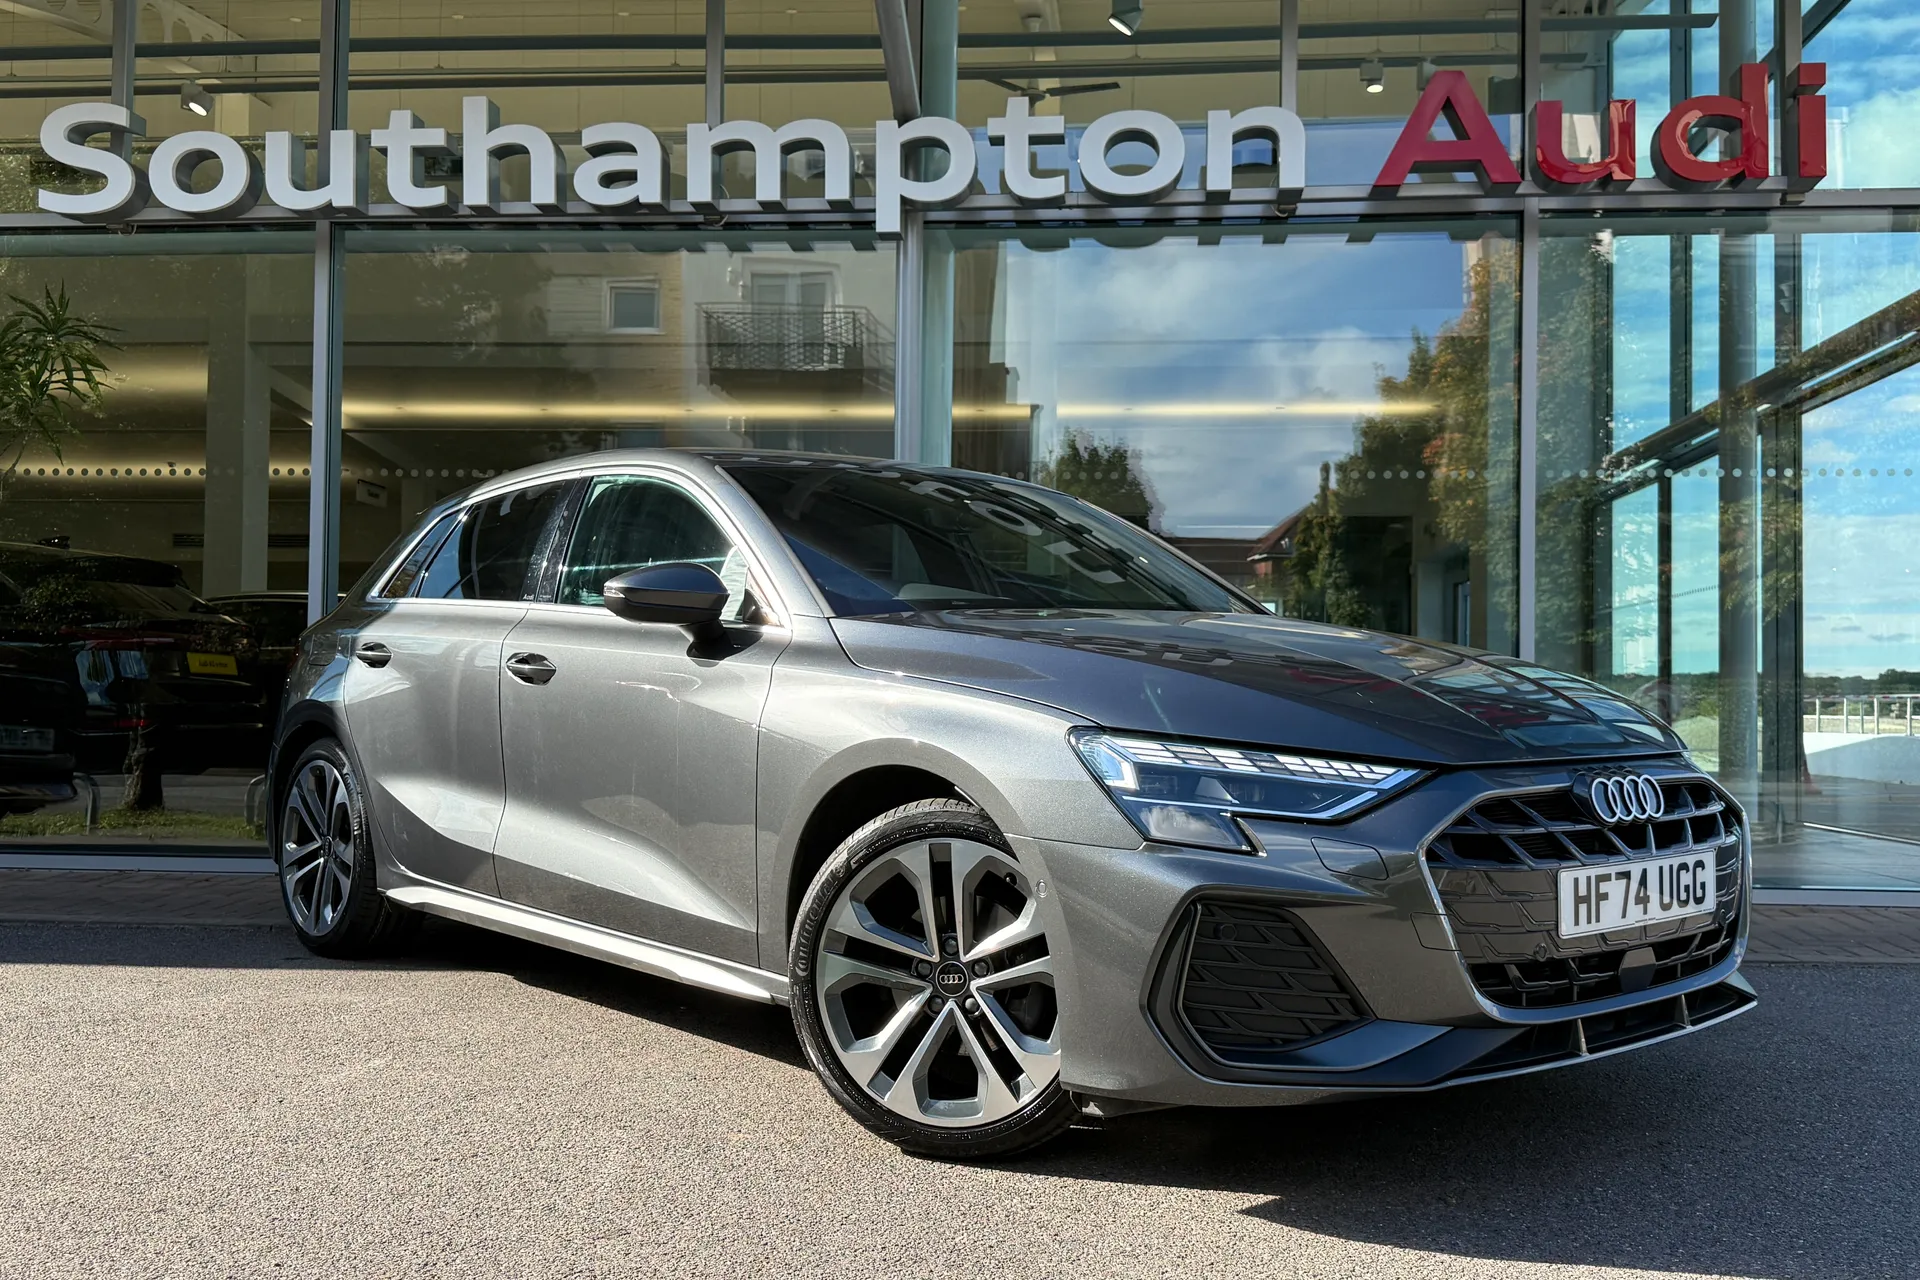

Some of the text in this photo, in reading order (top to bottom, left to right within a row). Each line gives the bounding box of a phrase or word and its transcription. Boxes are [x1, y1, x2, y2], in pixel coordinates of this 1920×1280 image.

[37, 61, 1828, 239] Southampton Audi
[1573, 859, 1706, 926] HF74 UGG
